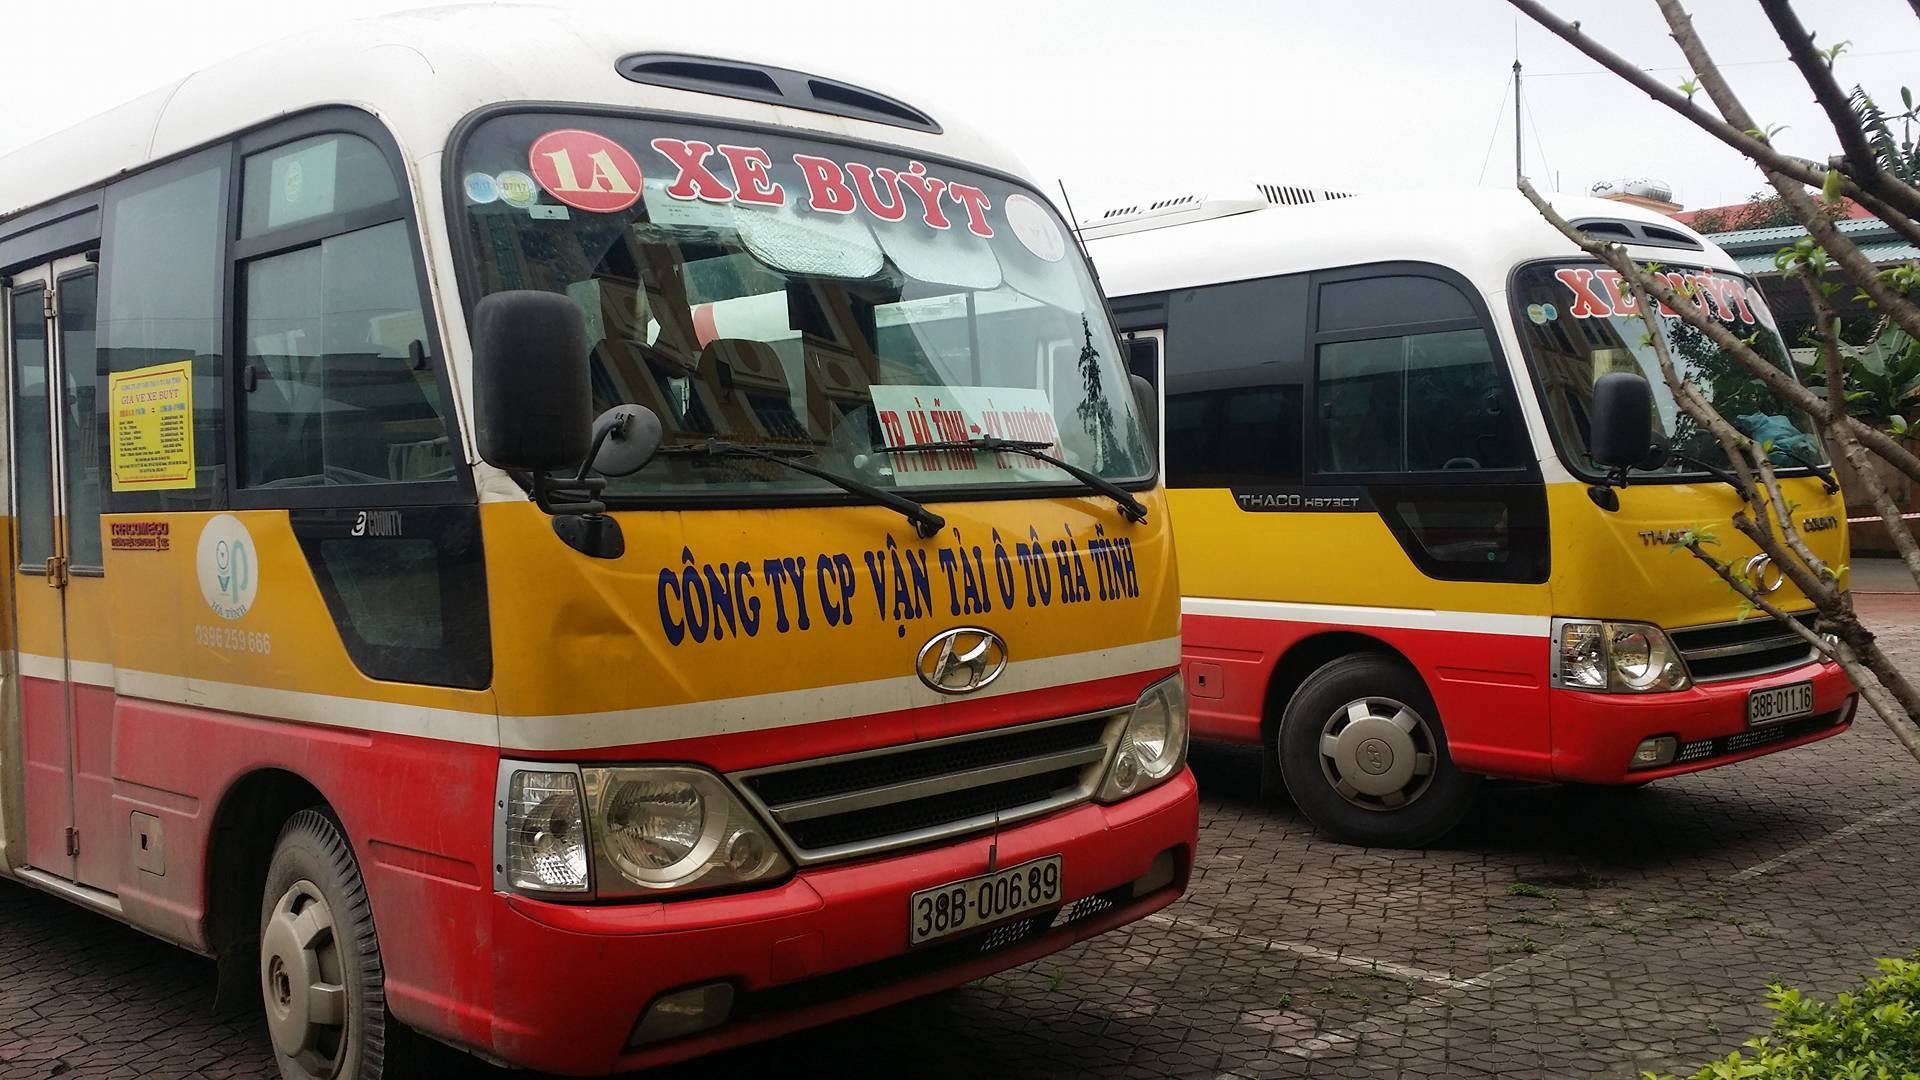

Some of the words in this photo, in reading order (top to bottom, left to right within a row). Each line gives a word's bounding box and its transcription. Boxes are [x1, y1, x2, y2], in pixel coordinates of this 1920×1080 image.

[541, 147, 637, 194] 1A
[651, 138, 785, 208] XE
[793, 153, 995, 239] BUÝT
[1555, 269, 1641, 319] XE
[1240, 494, 1301, 506] THACO
[368, 510, 402, 537] COUNTY
[1639, 528, 1693, 546] THA
[658, 545, 761, 647] CÔNG
[763, 556, 811, 633] TY
[817, 553, 856, 627] CP
[864, 532, 933, 638] VẬN
[939, 527, 992, 616] TẢI
[992, 527, 1014, 610] Ô
[1016, 524, 1051, 608] TÔ
[1052, 522, 1091, 604] HÀ
[1088, 523, 1140, 601] TĨNH
[224, 627, 246, 651] 259
[248, 631, 272, 656] 666
[1752, 686, 1811, 718] 38B-011.16
[917, 862, 1058, 937] 38B-006.89
